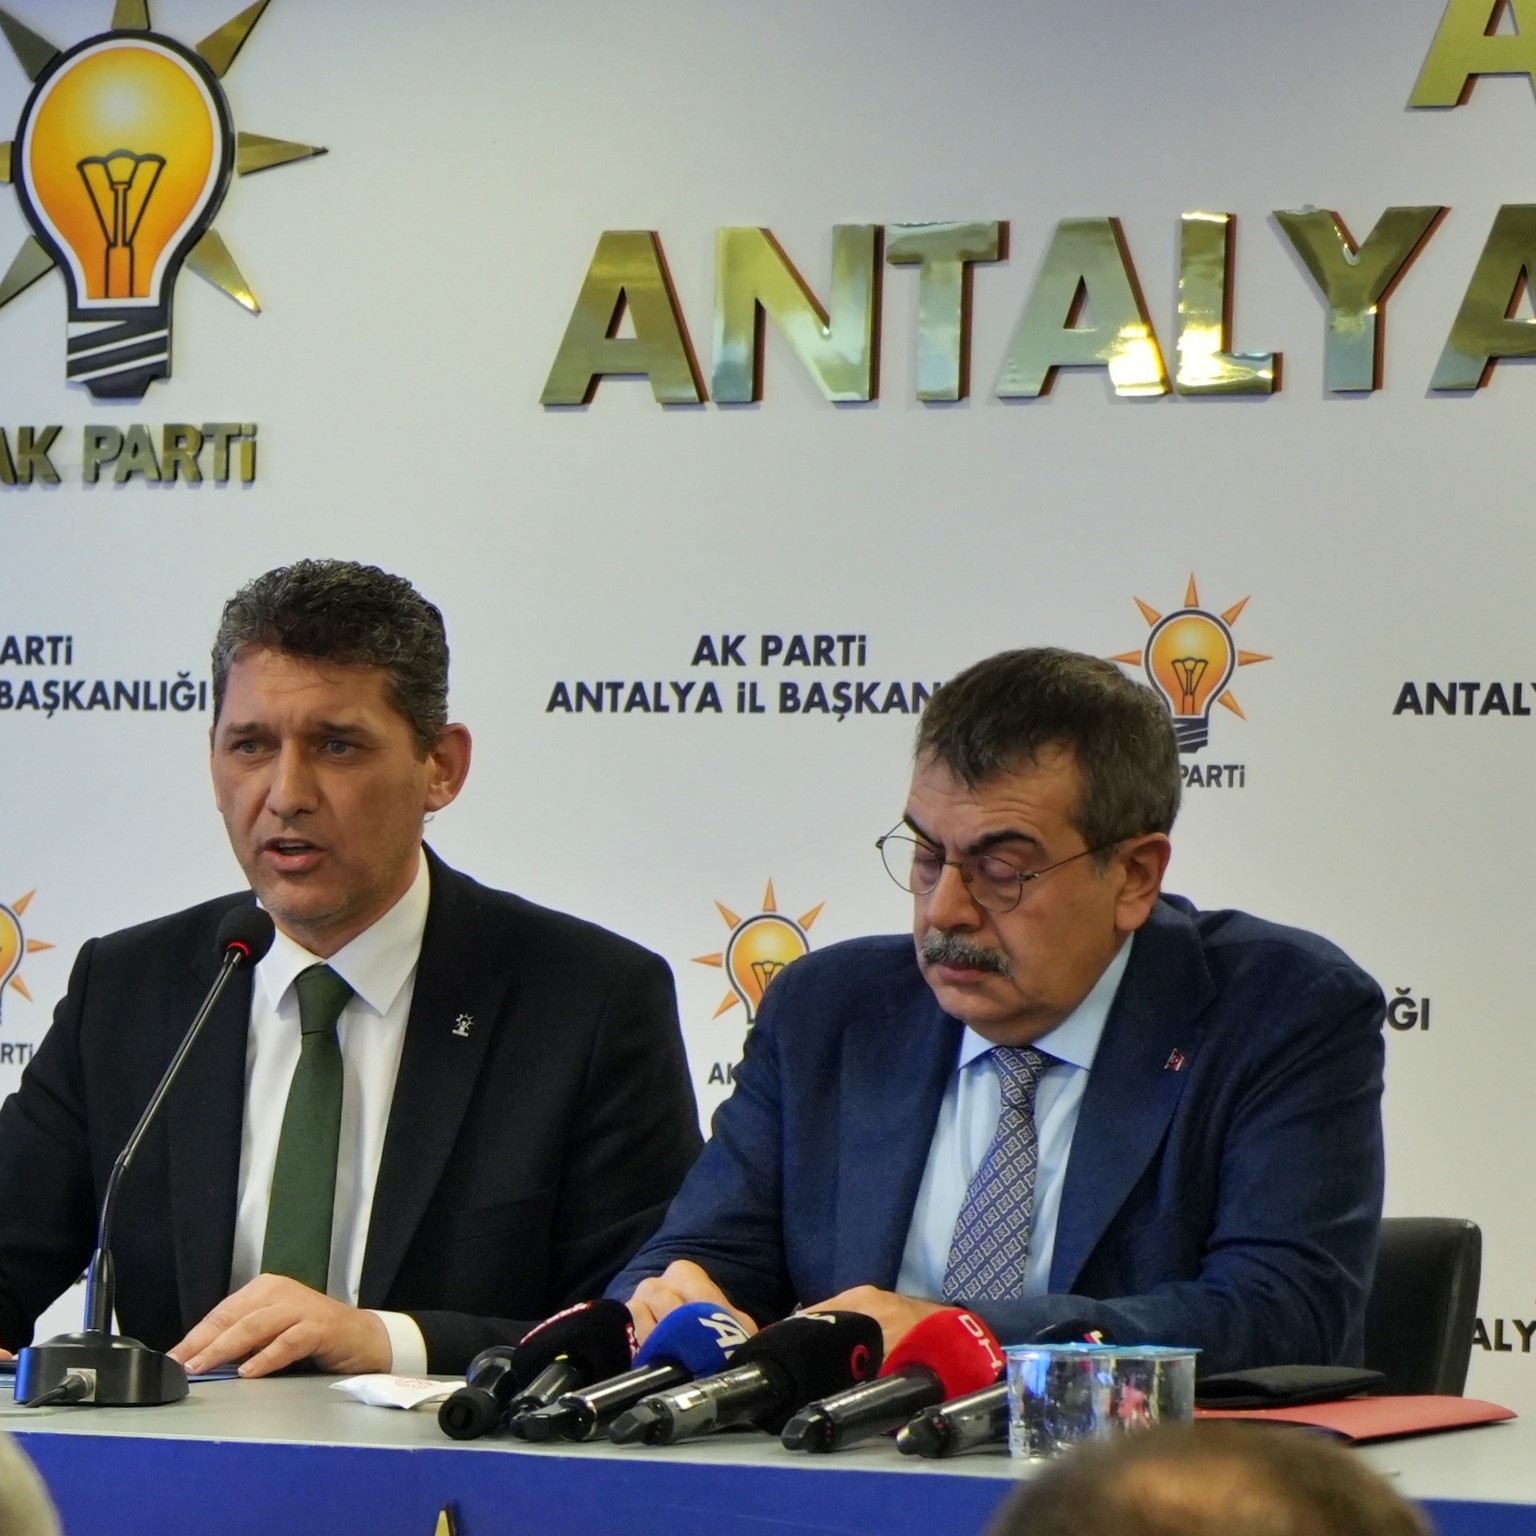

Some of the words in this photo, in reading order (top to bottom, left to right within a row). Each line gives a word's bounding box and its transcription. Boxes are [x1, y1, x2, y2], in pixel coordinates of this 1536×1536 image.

[540, 205, 1536, 404] ANTALYA
[691, 635, 746, 666] AK
[546, 682, 723, 713] ANTALYA
[1392, 682, 1536, 716] ANTAL
